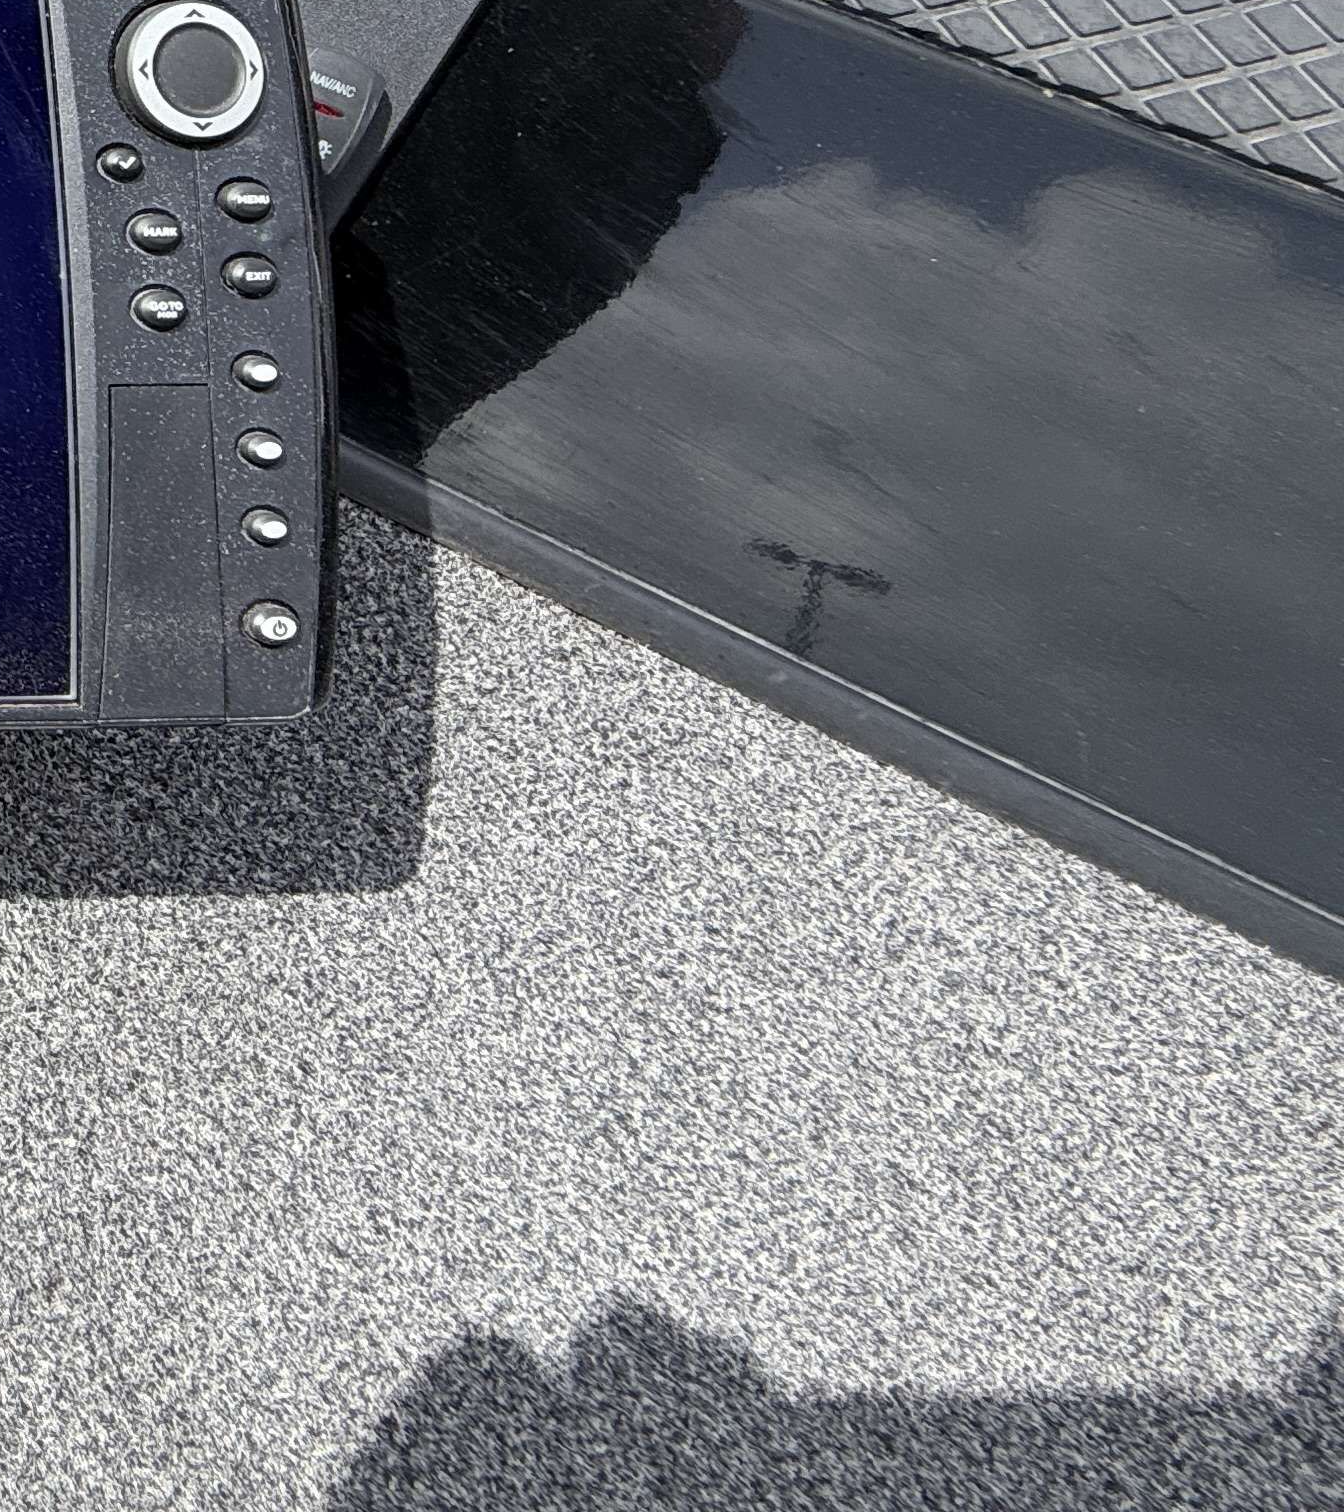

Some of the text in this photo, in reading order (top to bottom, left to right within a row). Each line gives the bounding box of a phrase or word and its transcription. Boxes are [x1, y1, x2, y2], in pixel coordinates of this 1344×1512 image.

[236, 194, 271, 205] MENU
[143, 226, 179, 237] MARK
[245, 270, 272, 281] EXIT
